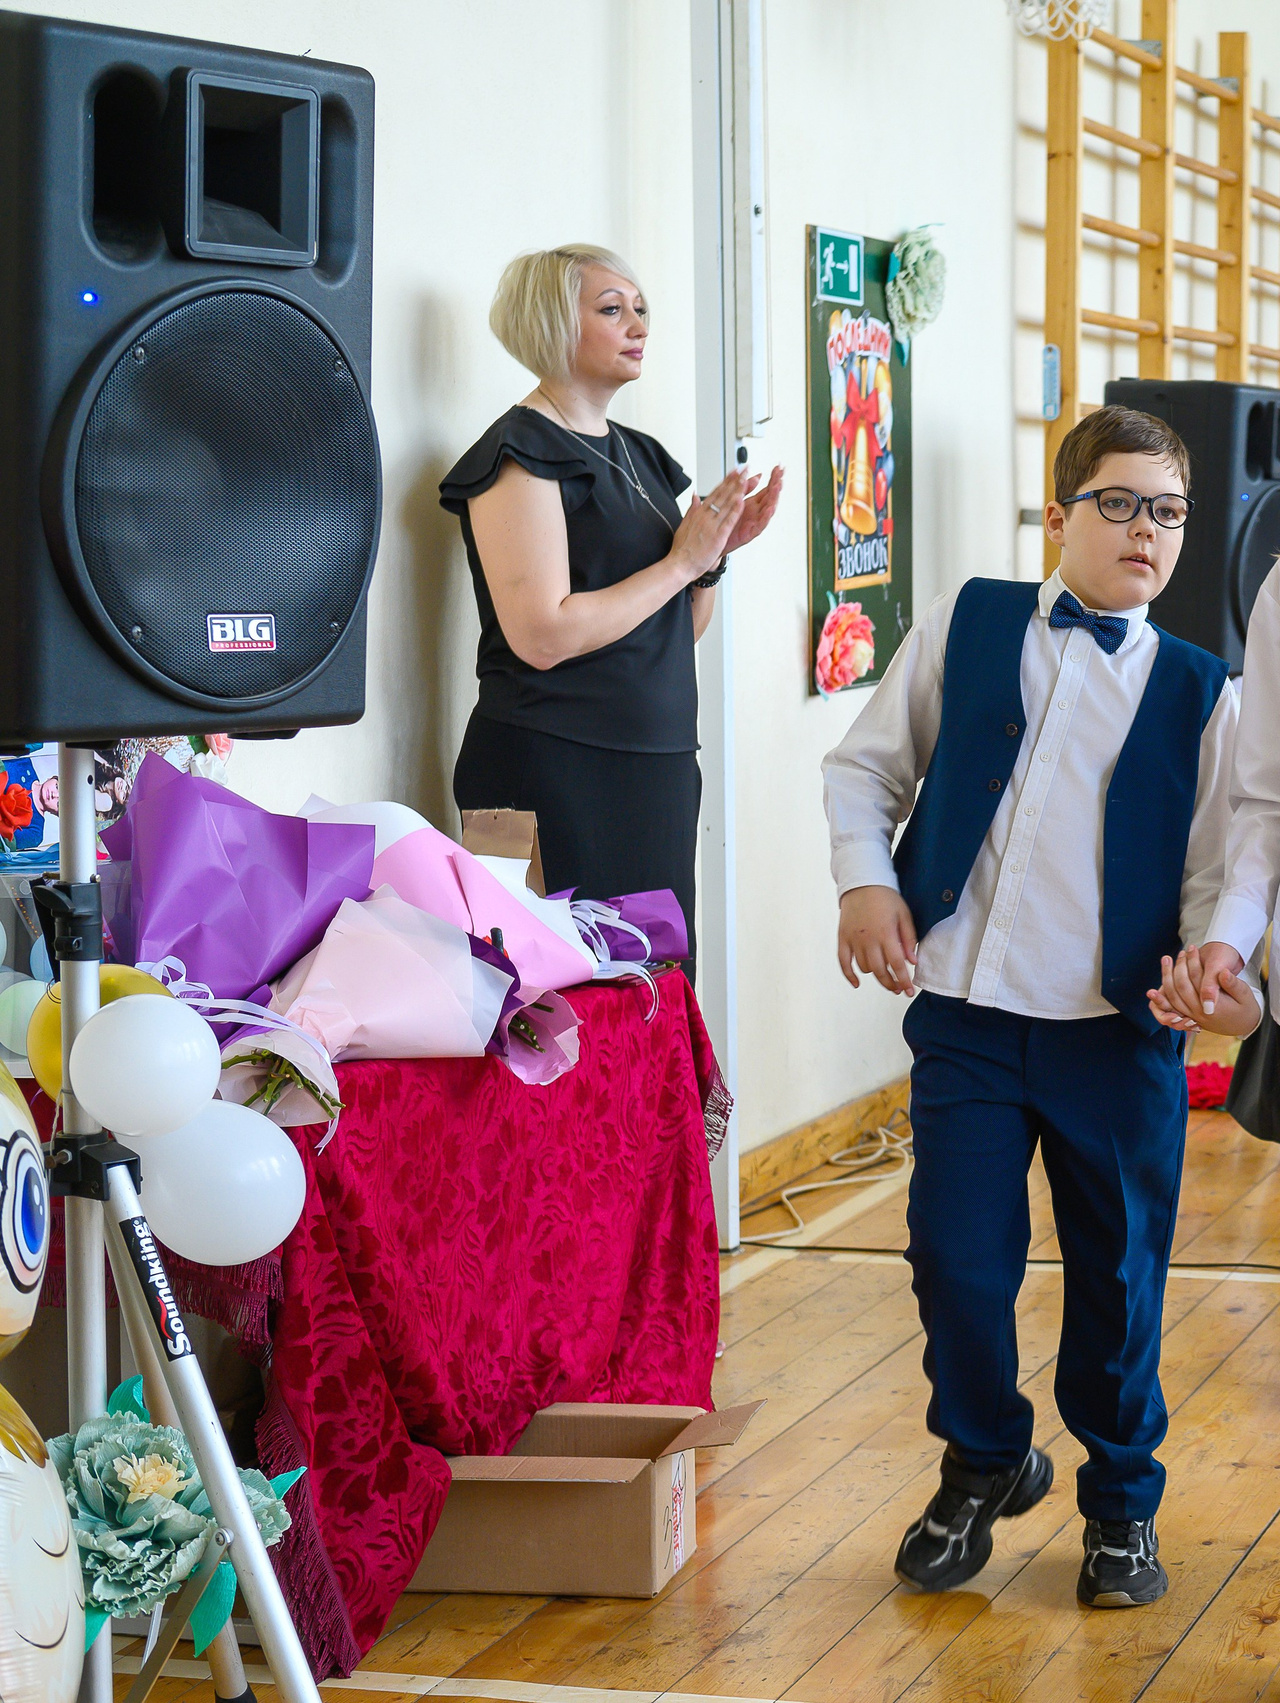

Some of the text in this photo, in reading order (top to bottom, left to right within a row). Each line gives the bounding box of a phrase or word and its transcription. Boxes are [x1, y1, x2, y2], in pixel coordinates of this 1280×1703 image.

[838, 537, 888, 579] ЗВОНОК
[212, 619, 270, 641] BLG
[133, 1221, 192, 1356] Soundking
